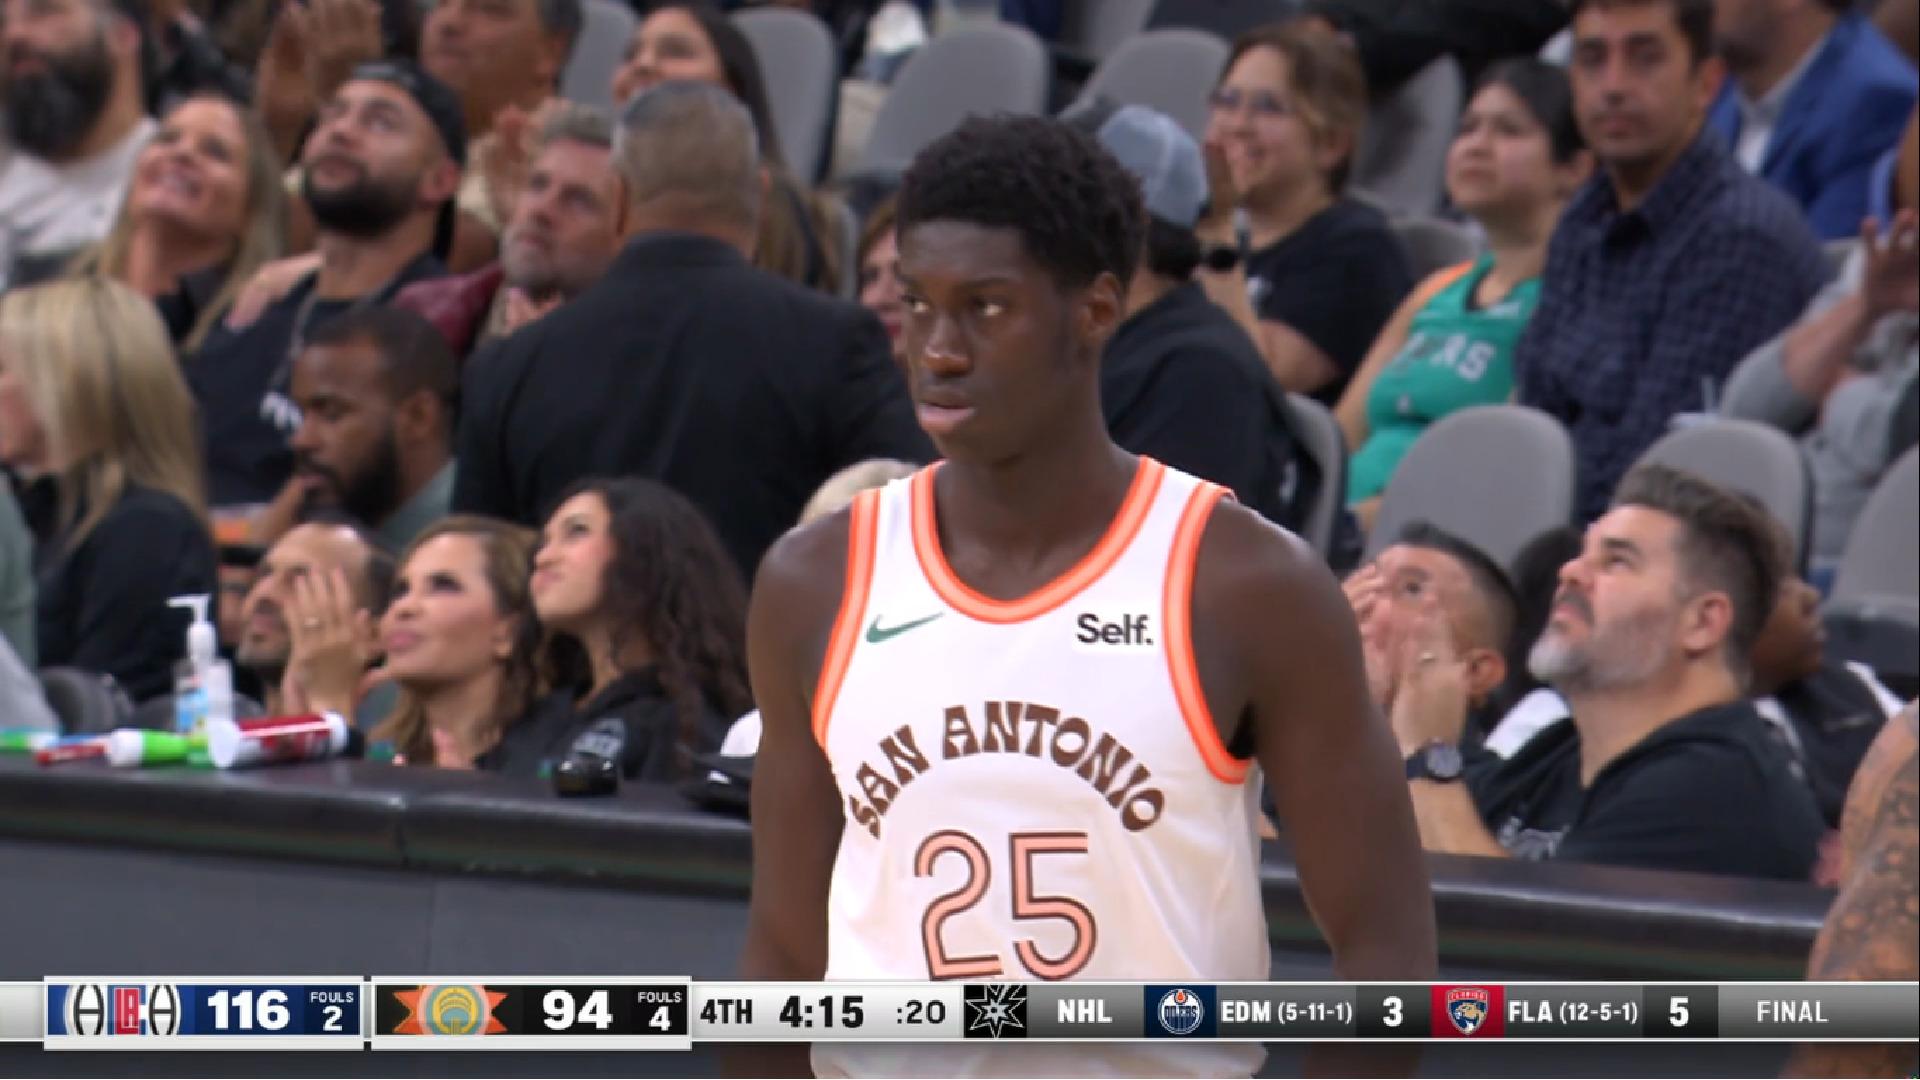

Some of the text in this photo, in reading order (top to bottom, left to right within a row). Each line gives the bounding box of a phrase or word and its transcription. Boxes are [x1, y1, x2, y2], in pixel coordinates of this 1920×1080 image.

[1076, 613, 1154, 645] Self.
[849, 701, 1165, 839] SAN ANTONIO
[914, 829, 1097, 981] 25
